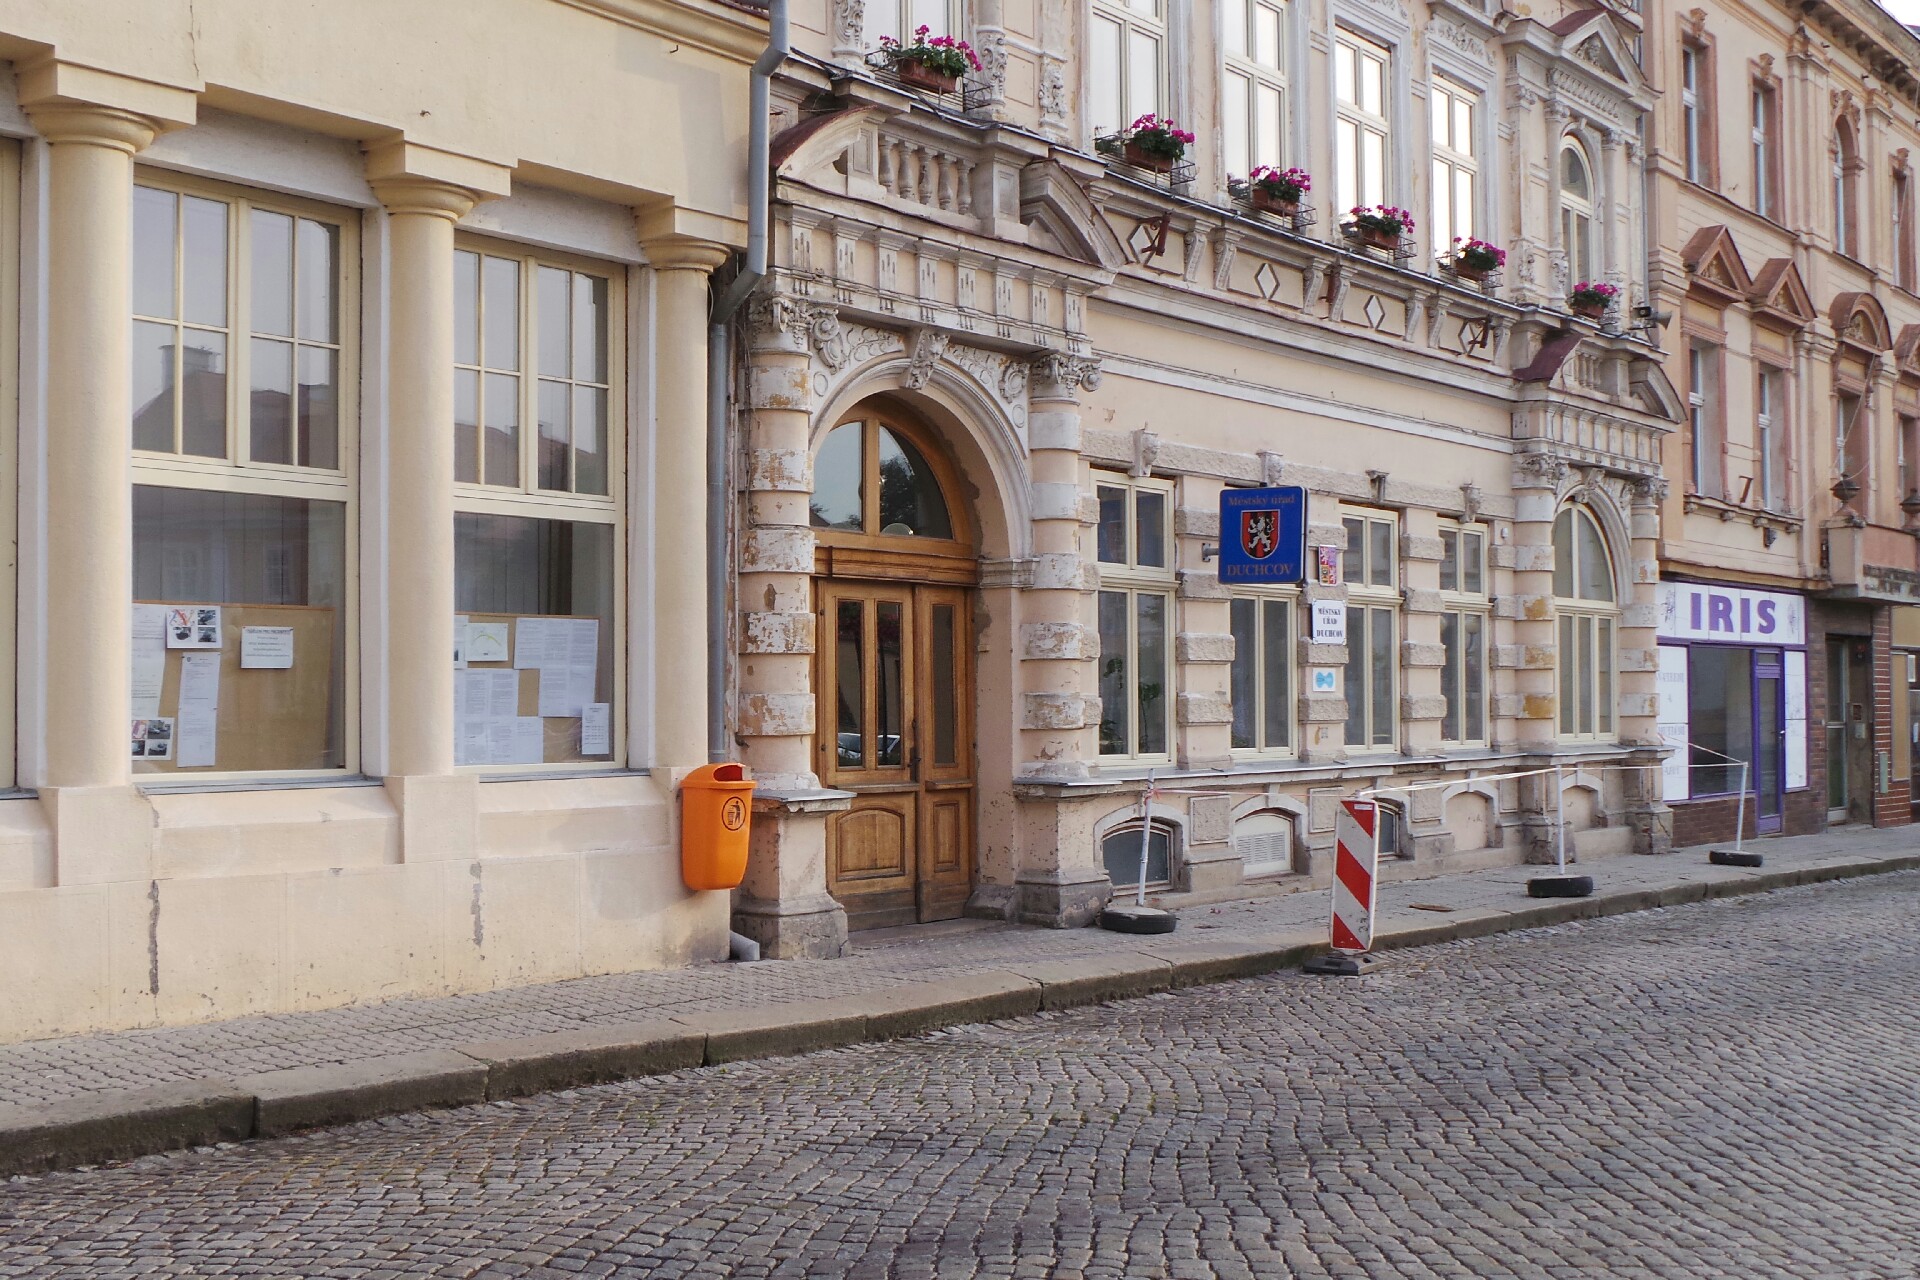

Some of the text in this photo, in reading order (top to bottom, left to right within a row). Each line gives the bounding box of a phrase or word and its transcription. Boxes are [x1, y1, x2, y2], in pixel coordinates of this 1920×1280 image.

[1227, 563, 1294, 577] DUCHCOV
[1690, 592, 1776, 634] IRIS
[1316, 629, 1343, 638] DUCHCOV
